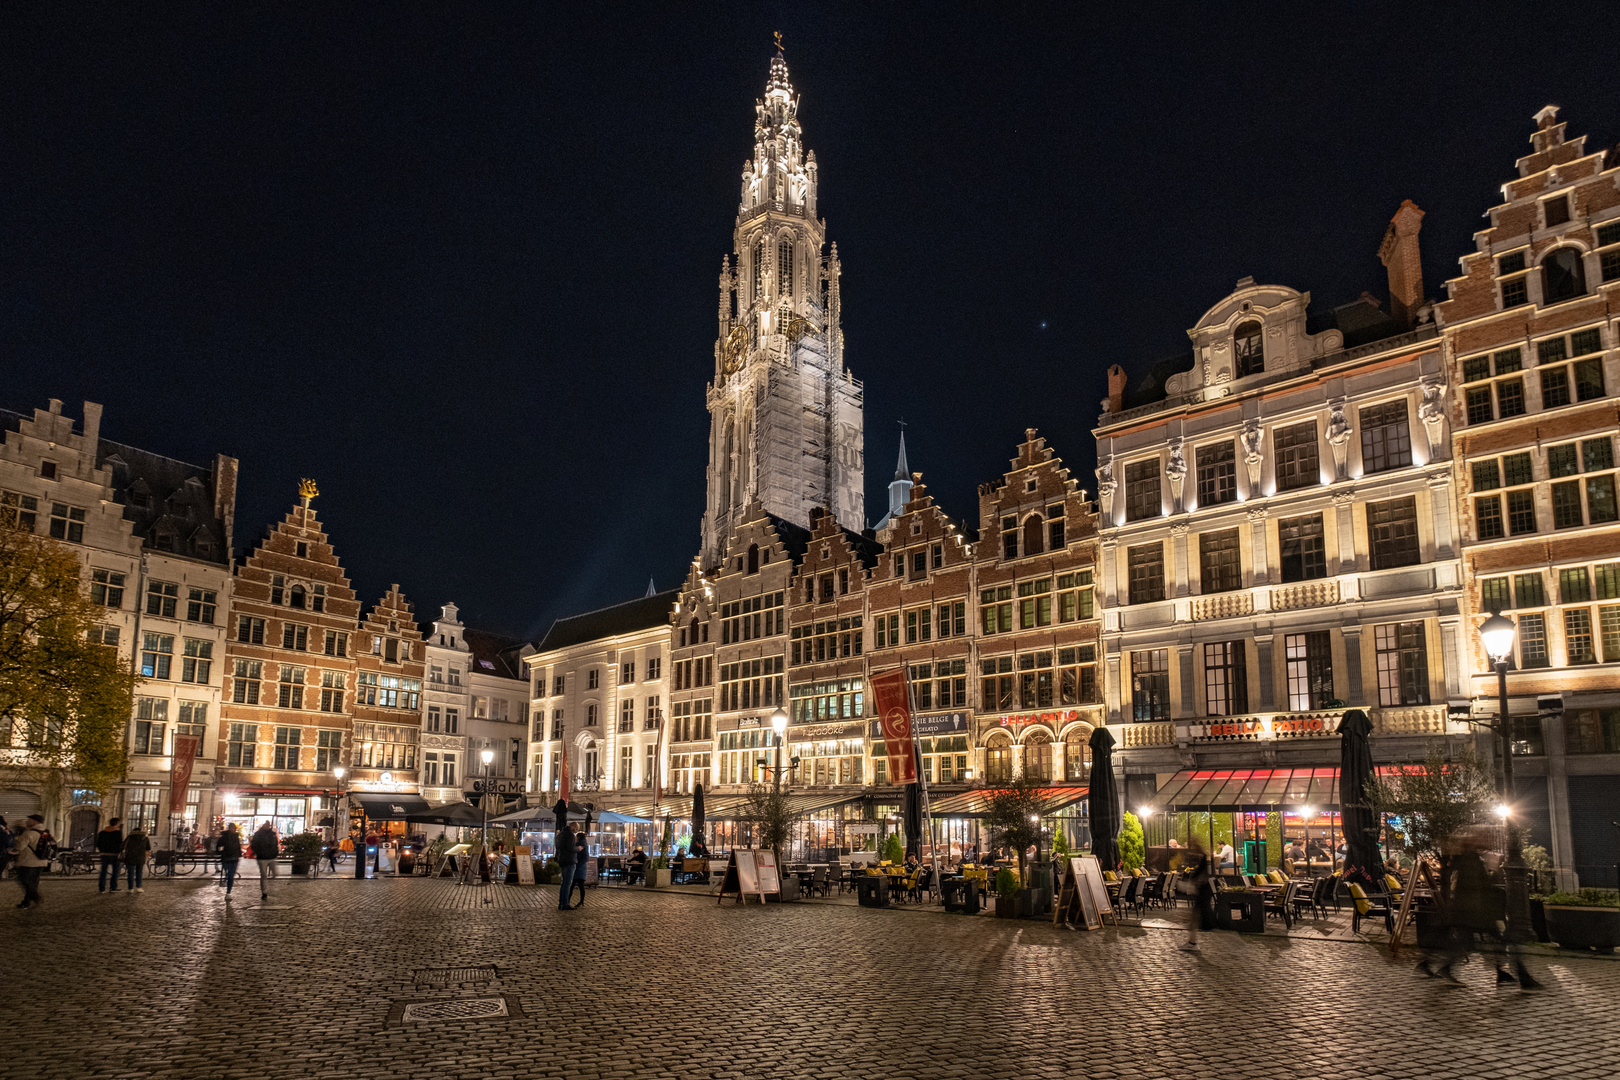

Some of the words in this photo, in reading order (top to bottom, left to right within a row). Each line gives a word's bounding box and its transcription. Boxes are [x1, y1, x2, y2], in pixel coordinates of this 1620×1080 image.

[928, 715, 949, 723] BELGE
[1000, 714, 1038, 726] BELLA
[1041, 711, 1078, 722] PATIO
[1211, 722, 1265, 735] BELLA
[1271, 719, 1322, 732] PATIO
